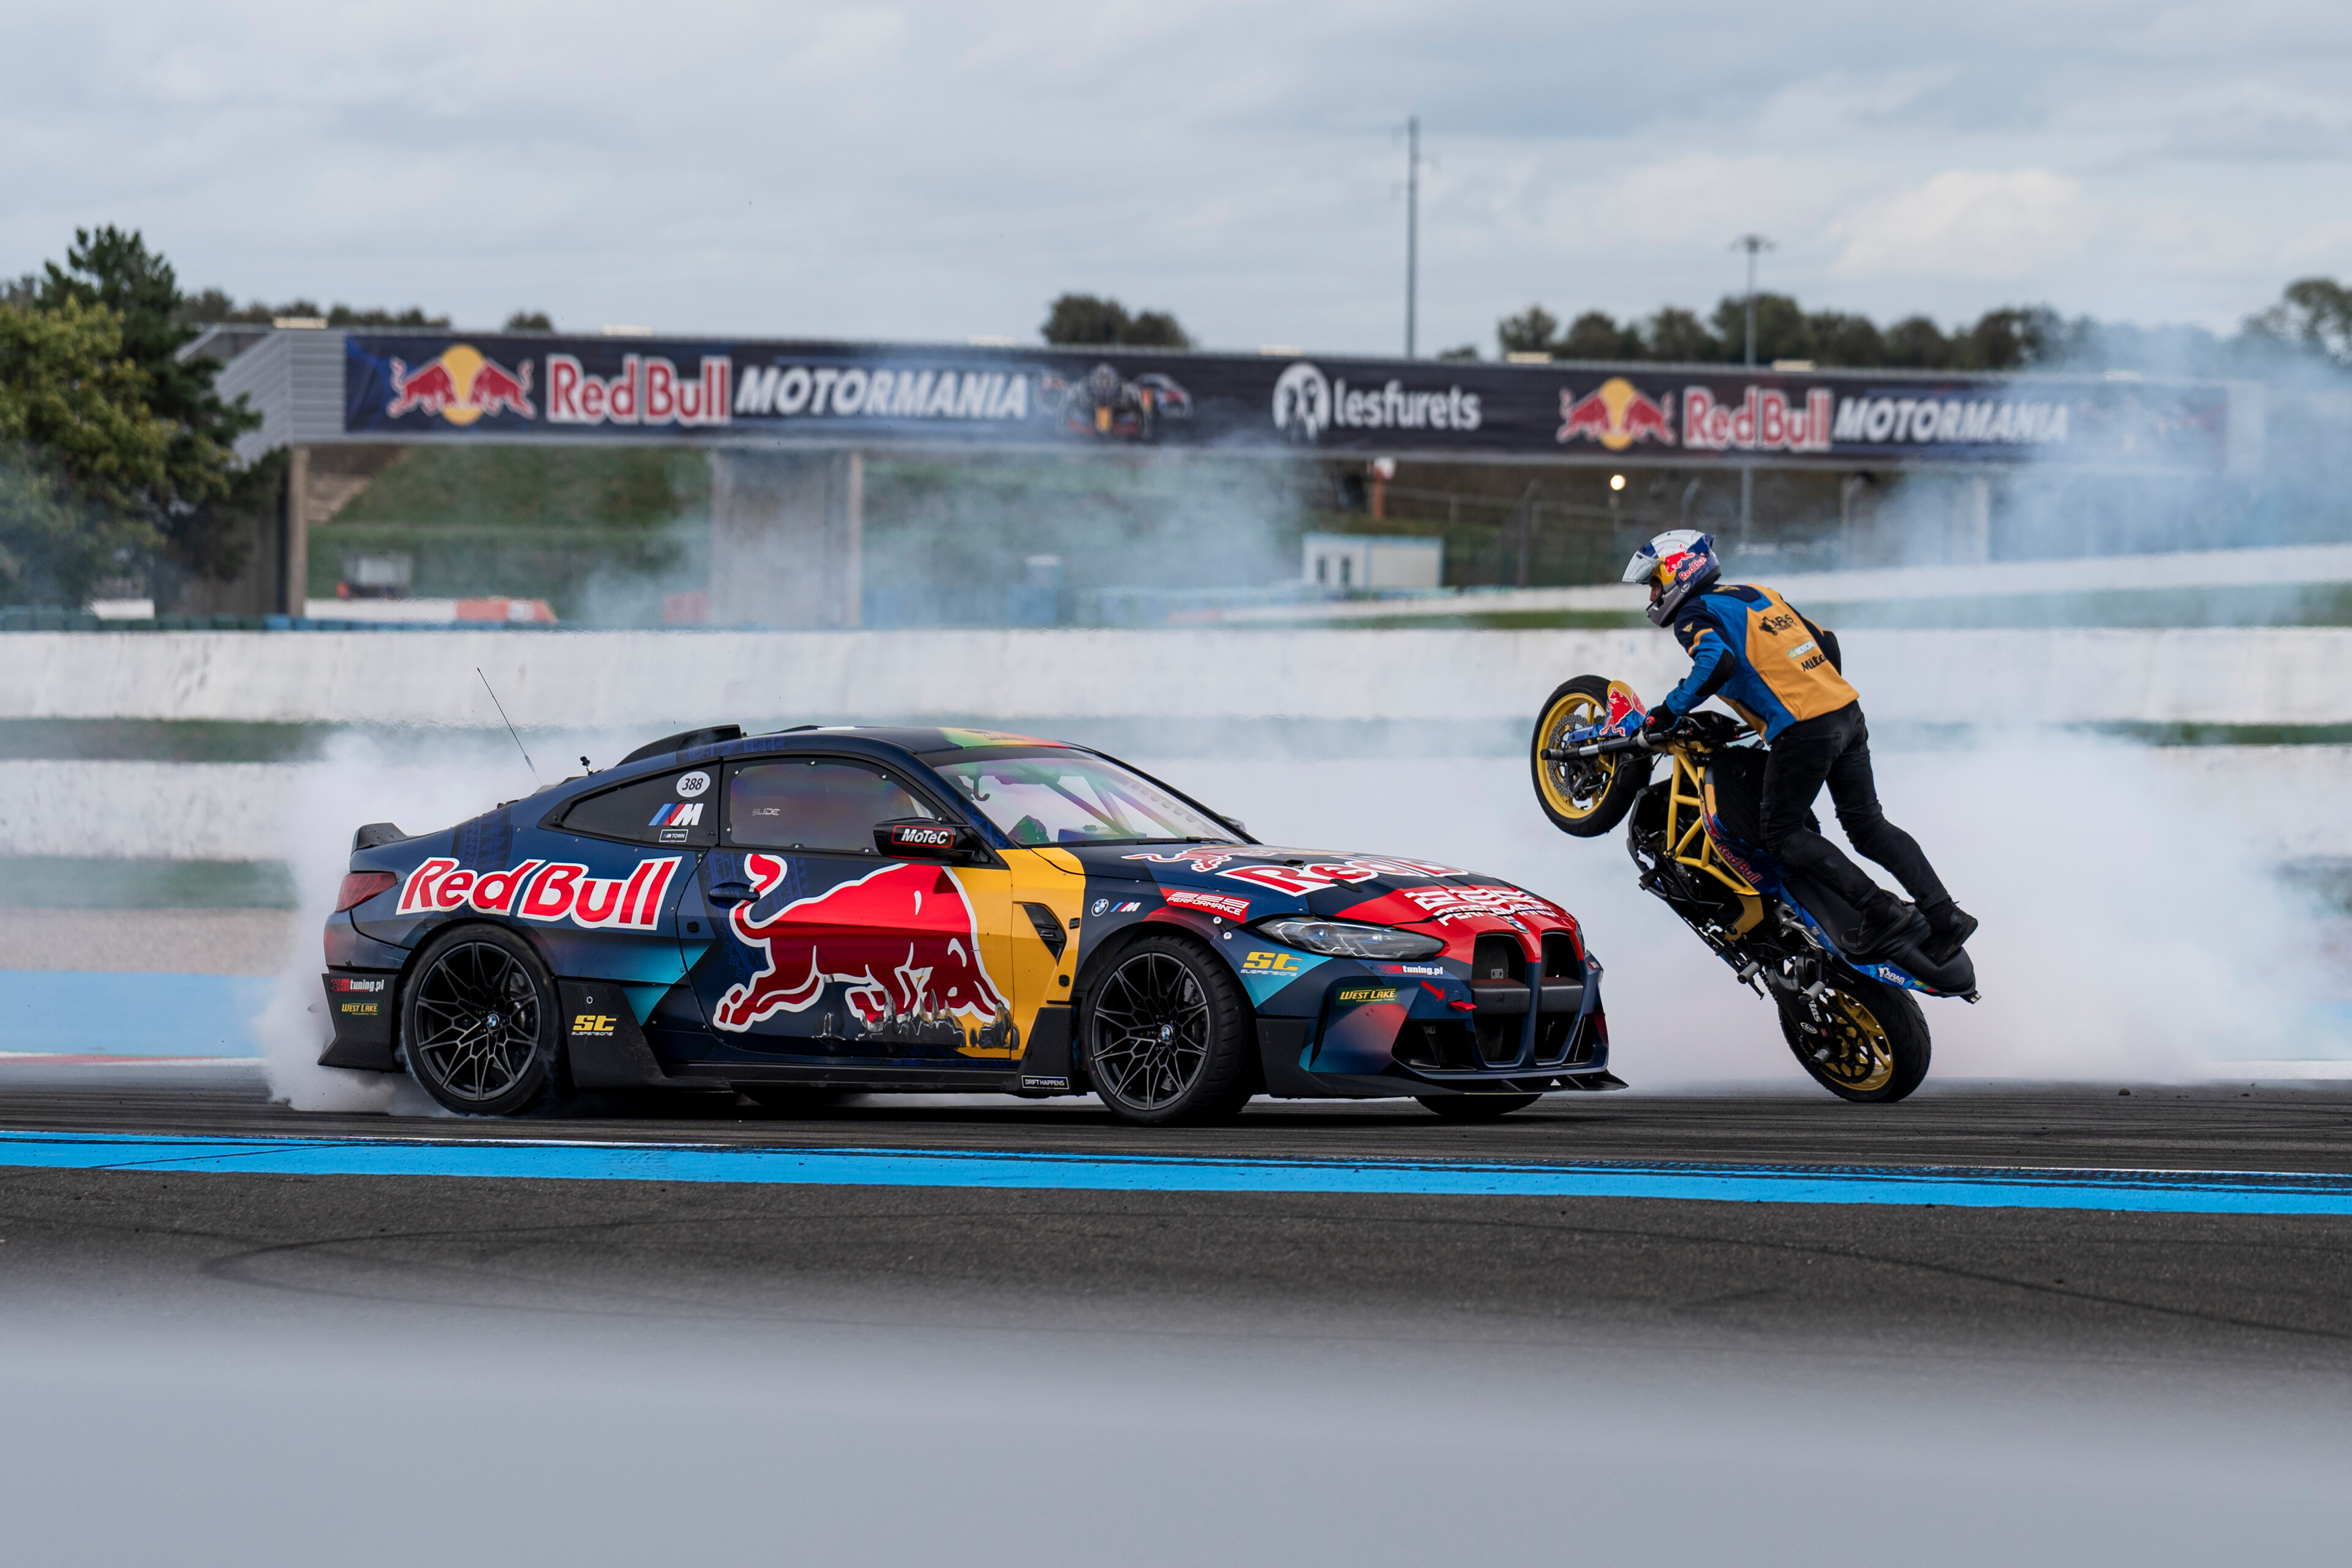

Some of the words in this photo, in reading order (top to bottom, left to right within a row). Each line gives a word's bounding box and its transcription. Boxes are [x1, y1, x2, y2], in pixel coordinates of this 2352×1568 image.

[549, 355, 639, 422] Red
[644, 357, 731, 424] Bull
[736, 367, 1028, 420] MOTORMANIA
[1334, 377, 1482, 430] lesfurets
[1685, 388, 1755, 447] Red
[1760, 390, 1831, 450] Bull
[1836, 397, 2068, 442] MOTORMANIA
[1679, 563, 1696, 581] Red
[682, 778, 704, 791] 388
[669, 803, 704, 826] M
[901, 828, 948, 845] MoTeC
[1716, 843, 1744, 865] Red
[1736, 862, 1763, 884] Bull
[398, 858, 543, 913] Red
[519, 858, 680, 929] Bull
[1120, 902, 1141, 912] M
[1166, 897, 1243, 916] PERFORMANCE
[1433, 903, 1559, 927] PERFORMANC
[1340, 991, 1369, 1000] WEST
[1370, 990, 1396, 998] LAKE
[342, 1003, 360, 1012] WEST
[361, 1003, 378, 1012] LAKE
